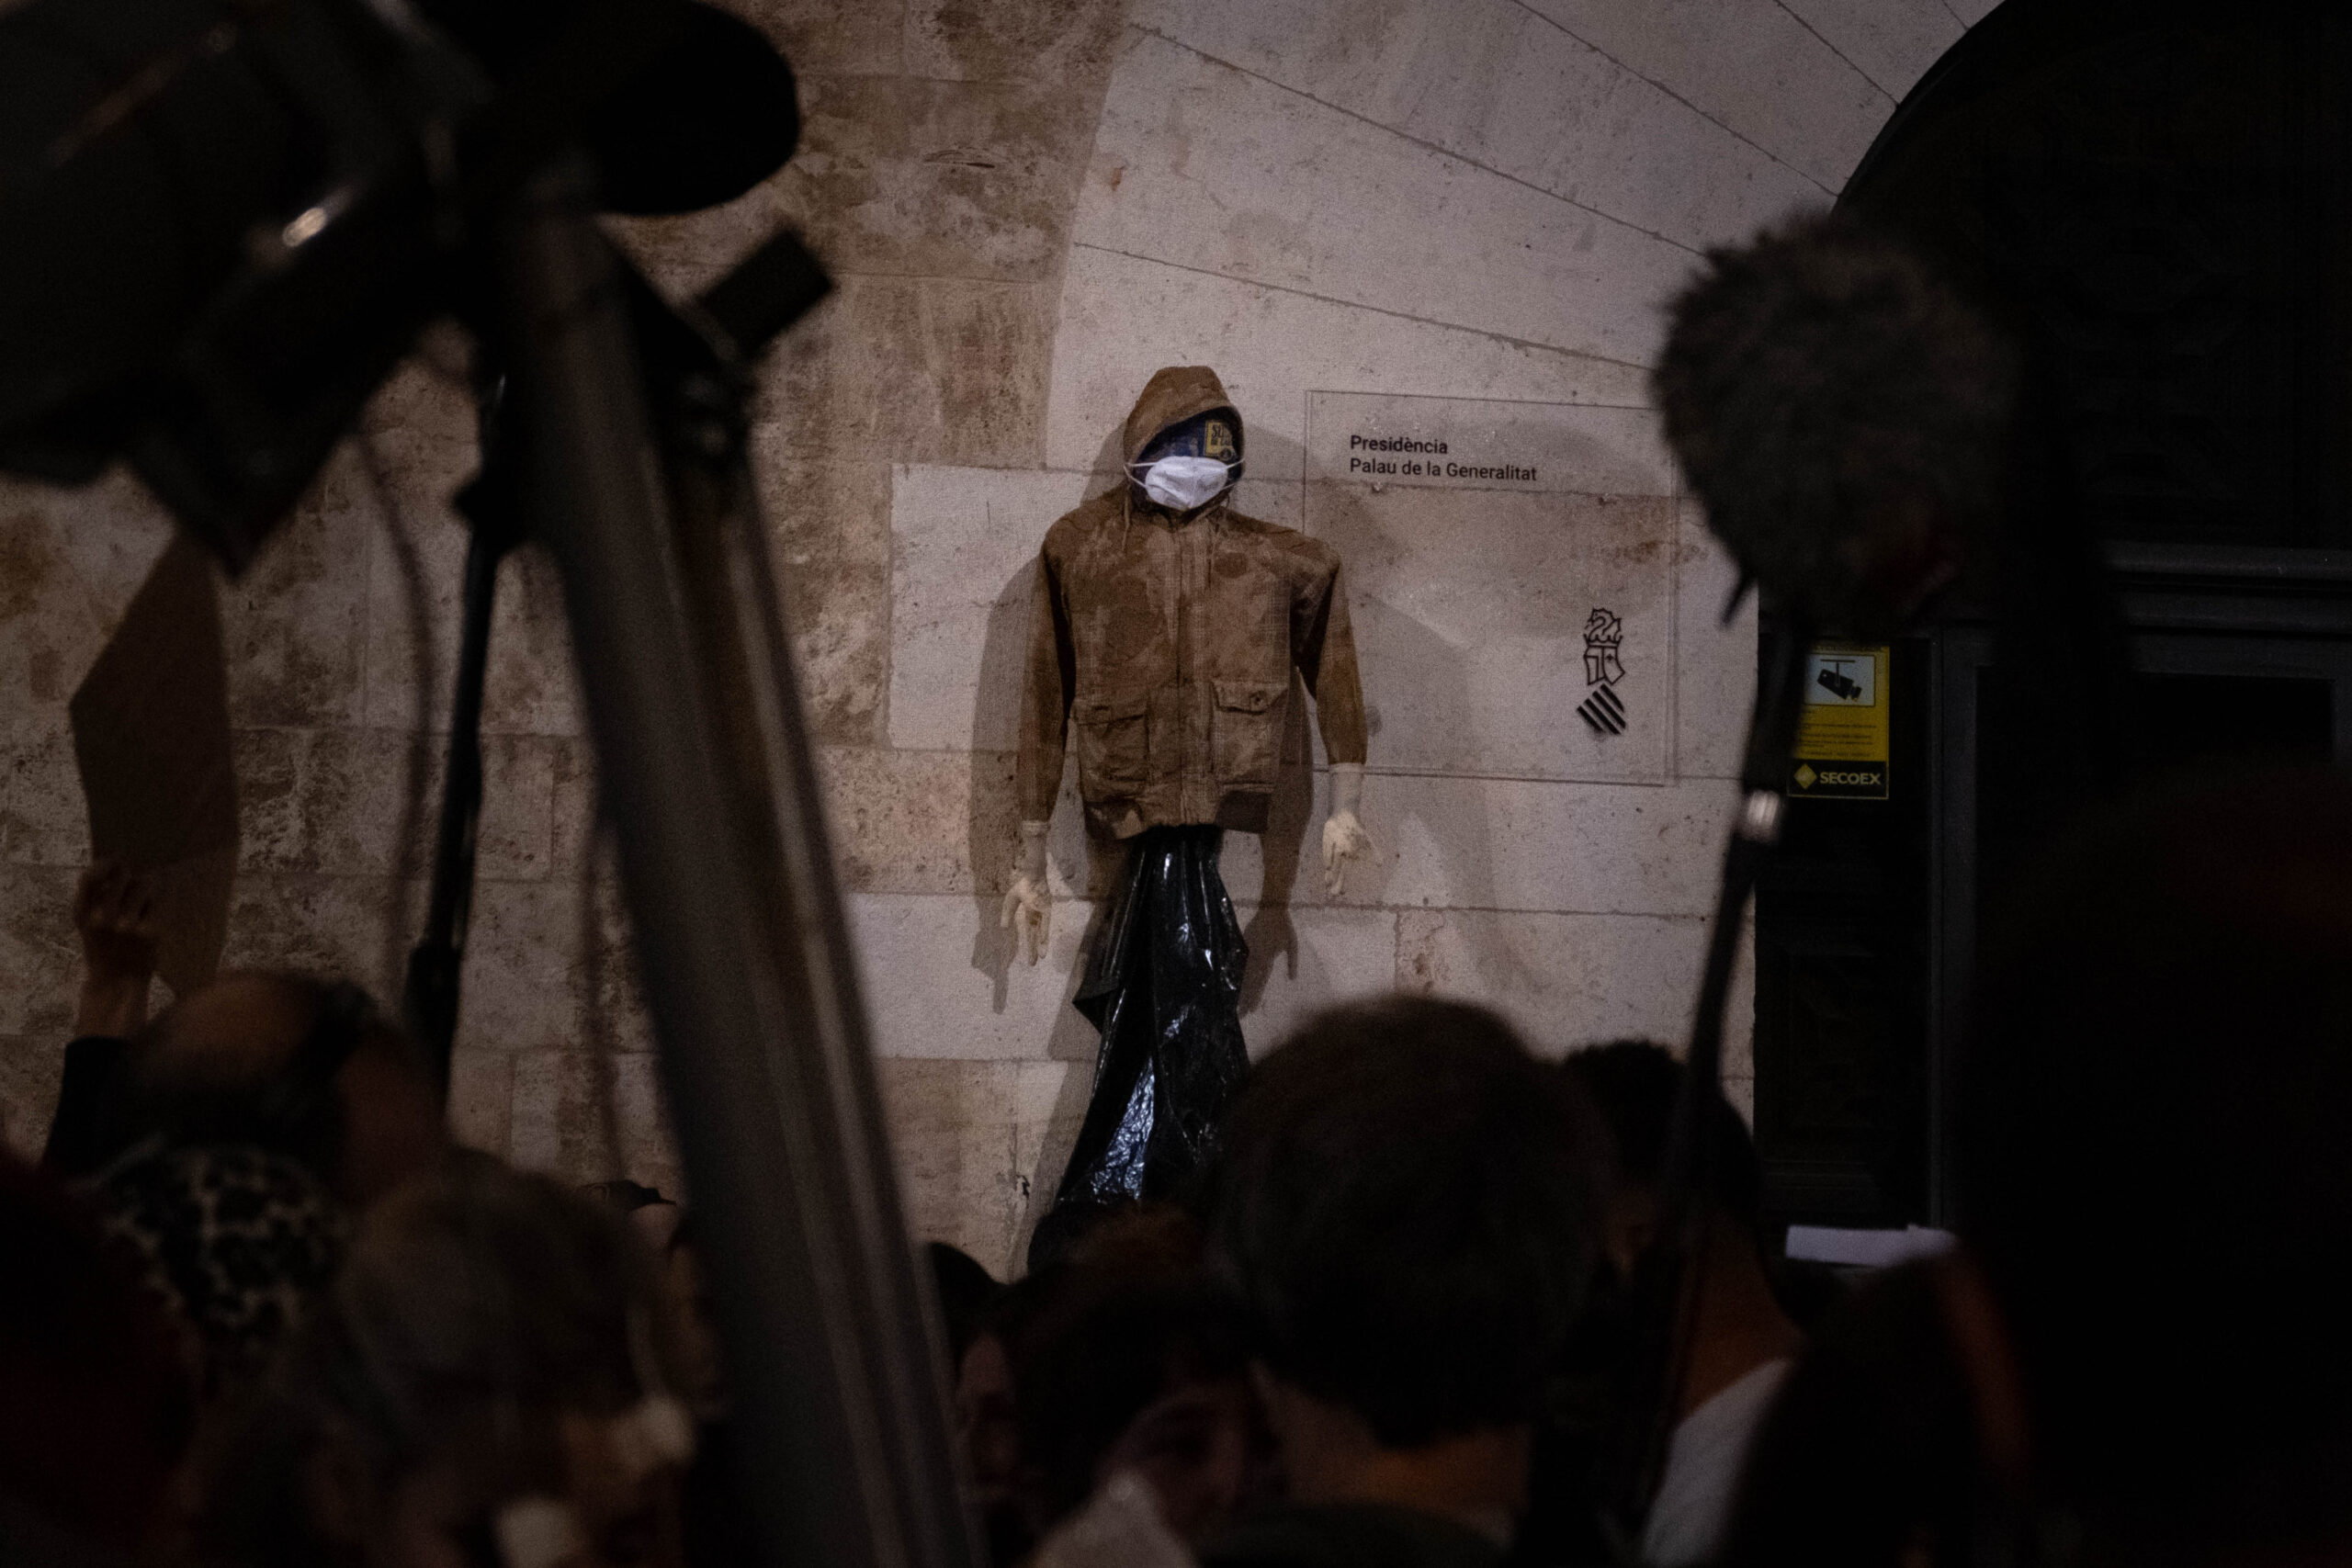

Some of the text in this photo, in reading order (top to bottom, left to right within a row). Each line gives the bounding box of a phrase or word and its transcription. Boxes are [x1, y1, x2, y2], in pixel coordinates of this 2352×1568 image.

[1351, 435, 1448, 454] Presidència
[1351, 458, 1537, 481] Palau de la Generalitat
[1819, 772, 1882, 785] SECOEX
